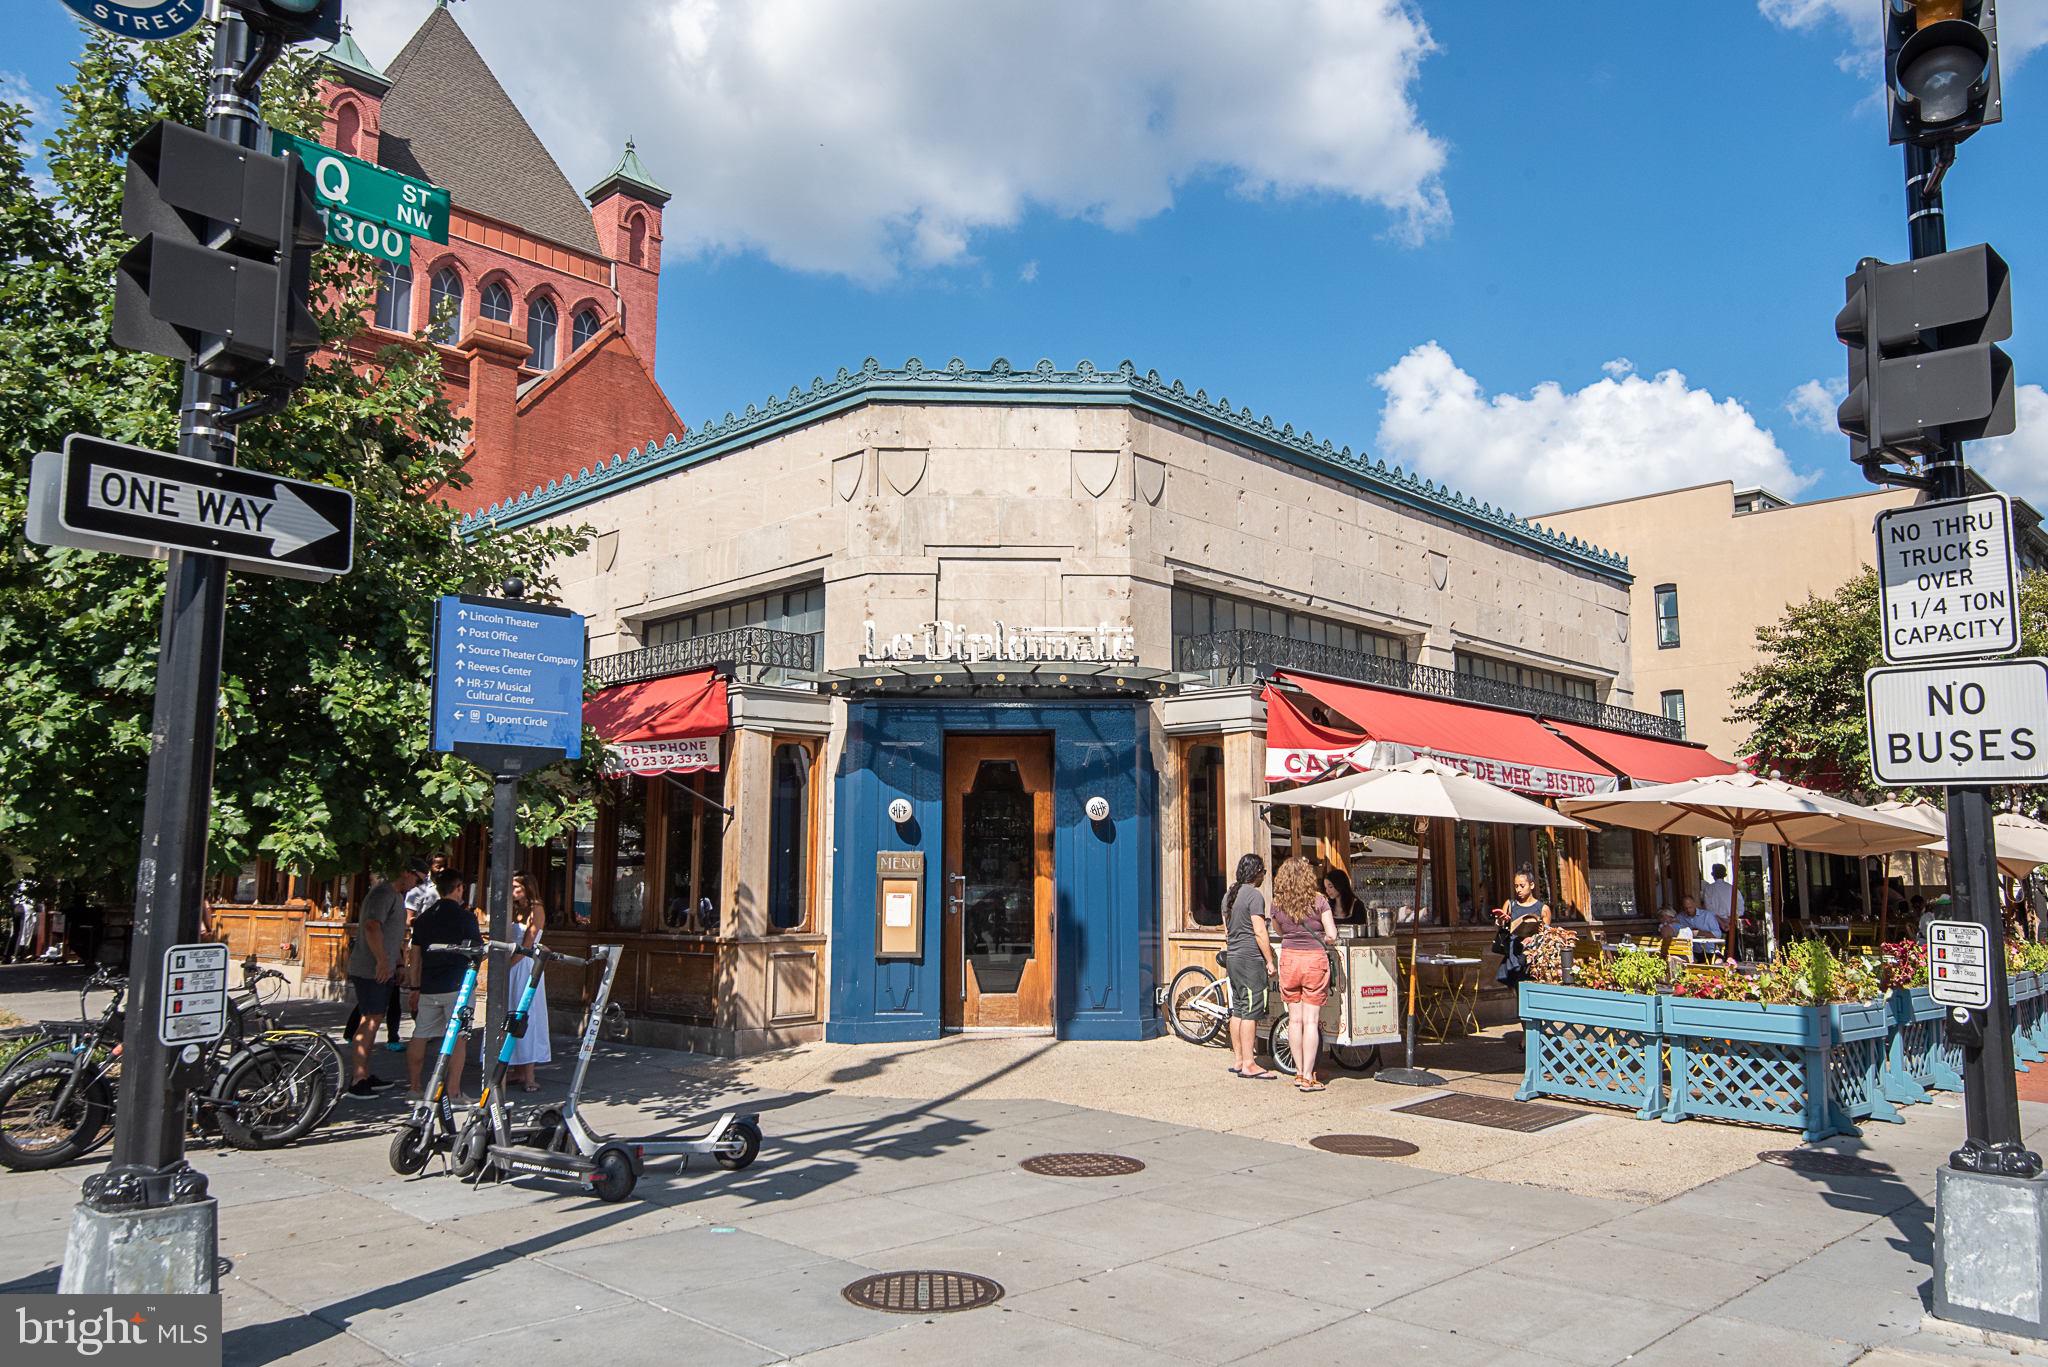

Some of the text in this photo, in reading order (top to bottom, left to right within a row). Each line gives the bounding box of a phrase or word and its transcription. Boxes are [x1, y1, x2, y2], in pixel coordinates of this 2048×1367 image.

[94, 0, 194, 31] STREET
[315, 157, 431, 207] Q ST
[397, 203, 433, 230] NW
[317, 207, 403, 257] 1300
[101, 472, 273, 532] ONE WAY
[1891, 512, 1993, 543] NO THRU
[1899, 540, 1989, 567] TRUCKS
[1918, 568, 1973, 591] OVER
[1892, 590, 2005, 620] 1 1/4 TON
[470, 612, 539, 628] Lincoln Theater
[1894, 617, 2005, 645] CAPACITY
[469, 628, 518, 642] Post Office
[863, 620, 1135, 664] Le Diplomate
[468, 645, 578, 667] Source Theater Company
[468, 661, 532, 676] Reeves Center
[466, 690, 535, 704] Cultural Center
[467, 678, 531, 692] HR-57 Musical
[1928, 683, 1985, 716] NO
[487, 714, 548, 727] Dupont Circle
[621, 741, 707, 755] TELEPHONE
[1888, 728, 2036, 764] BUSES
[624, 753, 708, 767] 20 23 32 33 33
[1285, 752, 1355, 773] CAF
[1475, 762, 1495, 781] DE
[1501, 765, 1531, 786] MER
[1547, 773, 1595, 794] BISTRO
[881, 857, 921, 870] MENU
